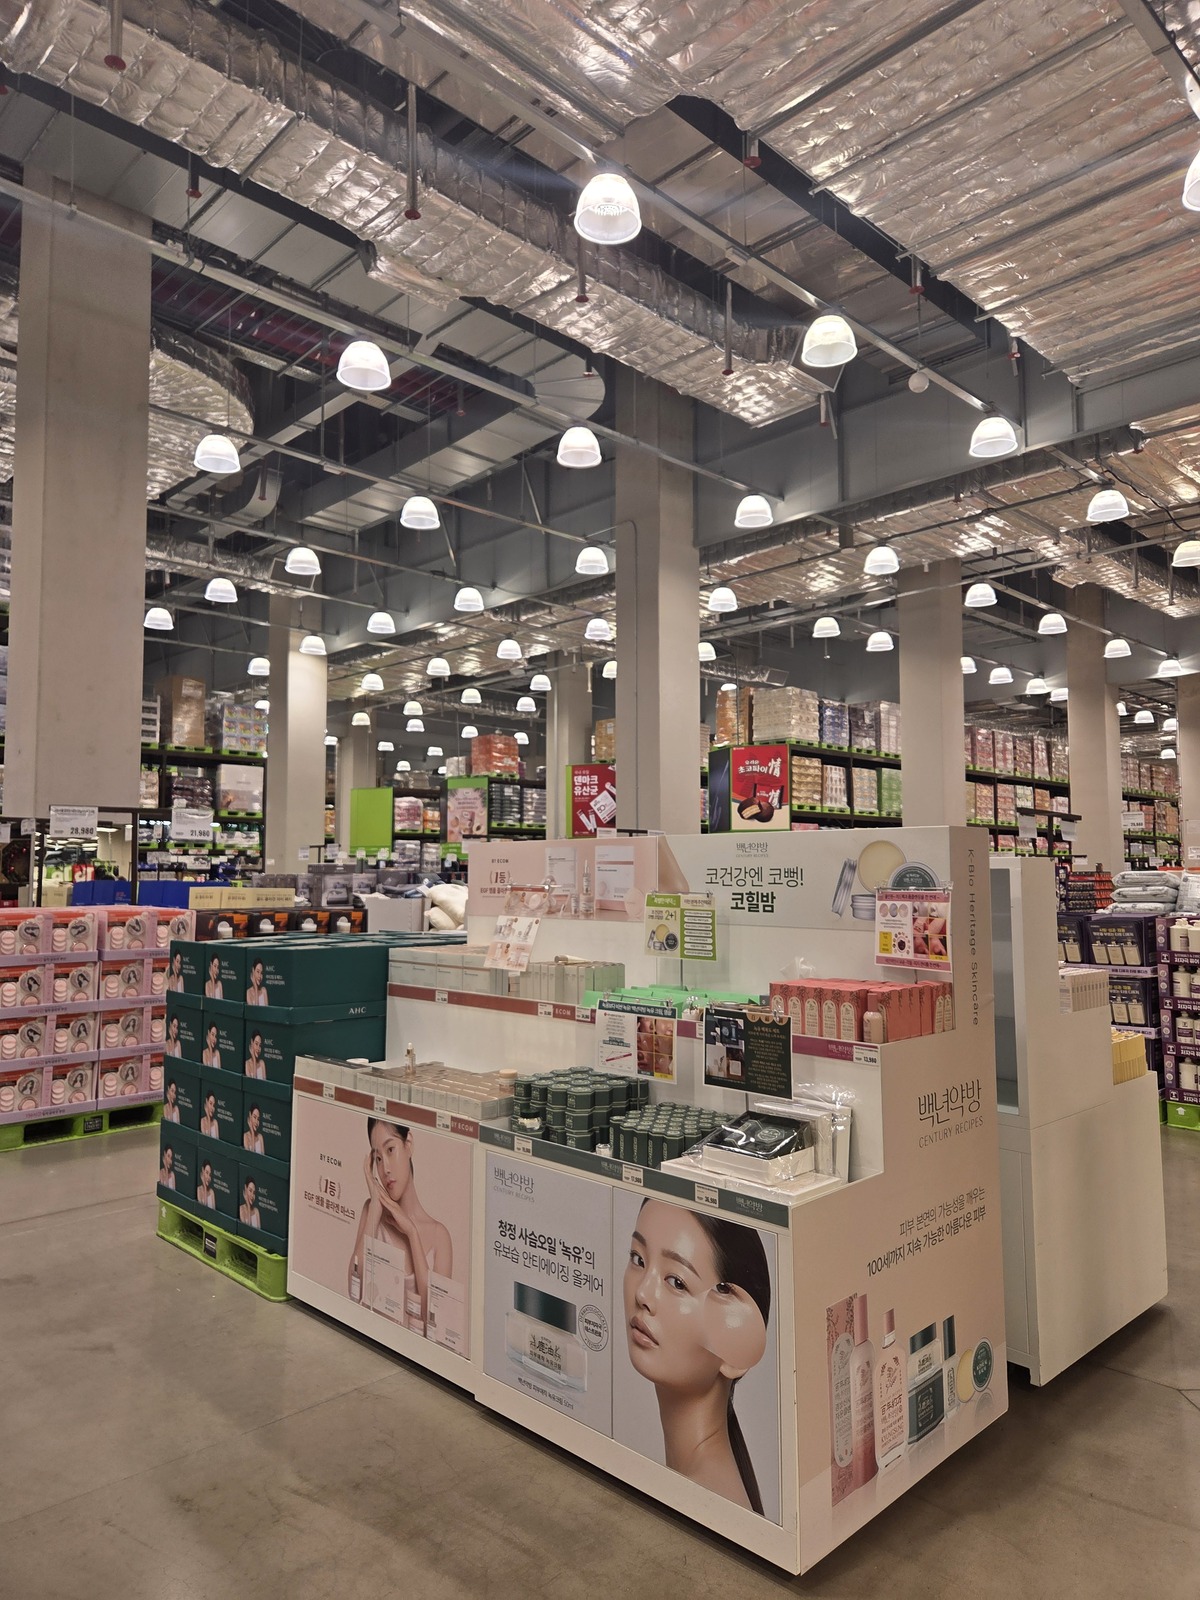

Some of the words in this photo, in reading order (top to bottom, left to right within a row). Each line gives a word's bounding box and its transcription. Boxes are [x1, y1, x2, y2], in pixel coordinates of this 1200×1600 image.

[768, 757, 781, 778] 情
[574, 785, 598, 796] 유산균
[70, 827, 94, 836] 28,980
[190, 829, 210, 838] 21,980
[736, 842, 768, 854] 백년약방
[705, 866, 763, 887] 코건강엔
[767, 866, 804, 887] 코뻥!
[730, 891, 776, 914] 코힐밤
[665, 910, 677, 921] 2+1
[348, 1006, 367, 1015] AHC
[555, 1008, 571, 1016] ECOM
[918, 1079, 982, 1128] 백년약방
[458, 1122, 474, 1133] ECOM
[918, 1127, 952, 1149] CENTURY
[955, 1116, 984, 1135] RECIPES
[319, 1153, 327, 1162] BY
[327, 1155, 342, 1168] ECOM
[493, 1165, 534, 1195] 백년약방
[304, 1190, 315, 1202] EGF
[340, 1204, 356, 1220] 마스크
[900, 1217, 915, 1237] 피부
[916, 1208, 937, 1229] 본연의
[938, 1195, 965, 1219] 가능성을
[966, 1186, 986, 1205] 깨우는
[498, 1219, 516, 1240] 청정
[518, 1226, 557, 1256] 사슴오일
[867, 1243, 905, 1277] 100세까지
[906, 1237, 922, 1256] 지속
[923, 1225, 944, 1248] 가능한
[945, 1214, 972, 1236] 아름다운
[973, 1205, 987, 1223] 피부
[493, 1240, 520, 1265] 유보습
[522, 1250, 569, 1284] 안티에이징
[573, 1267, 604, 1297] 올케어
